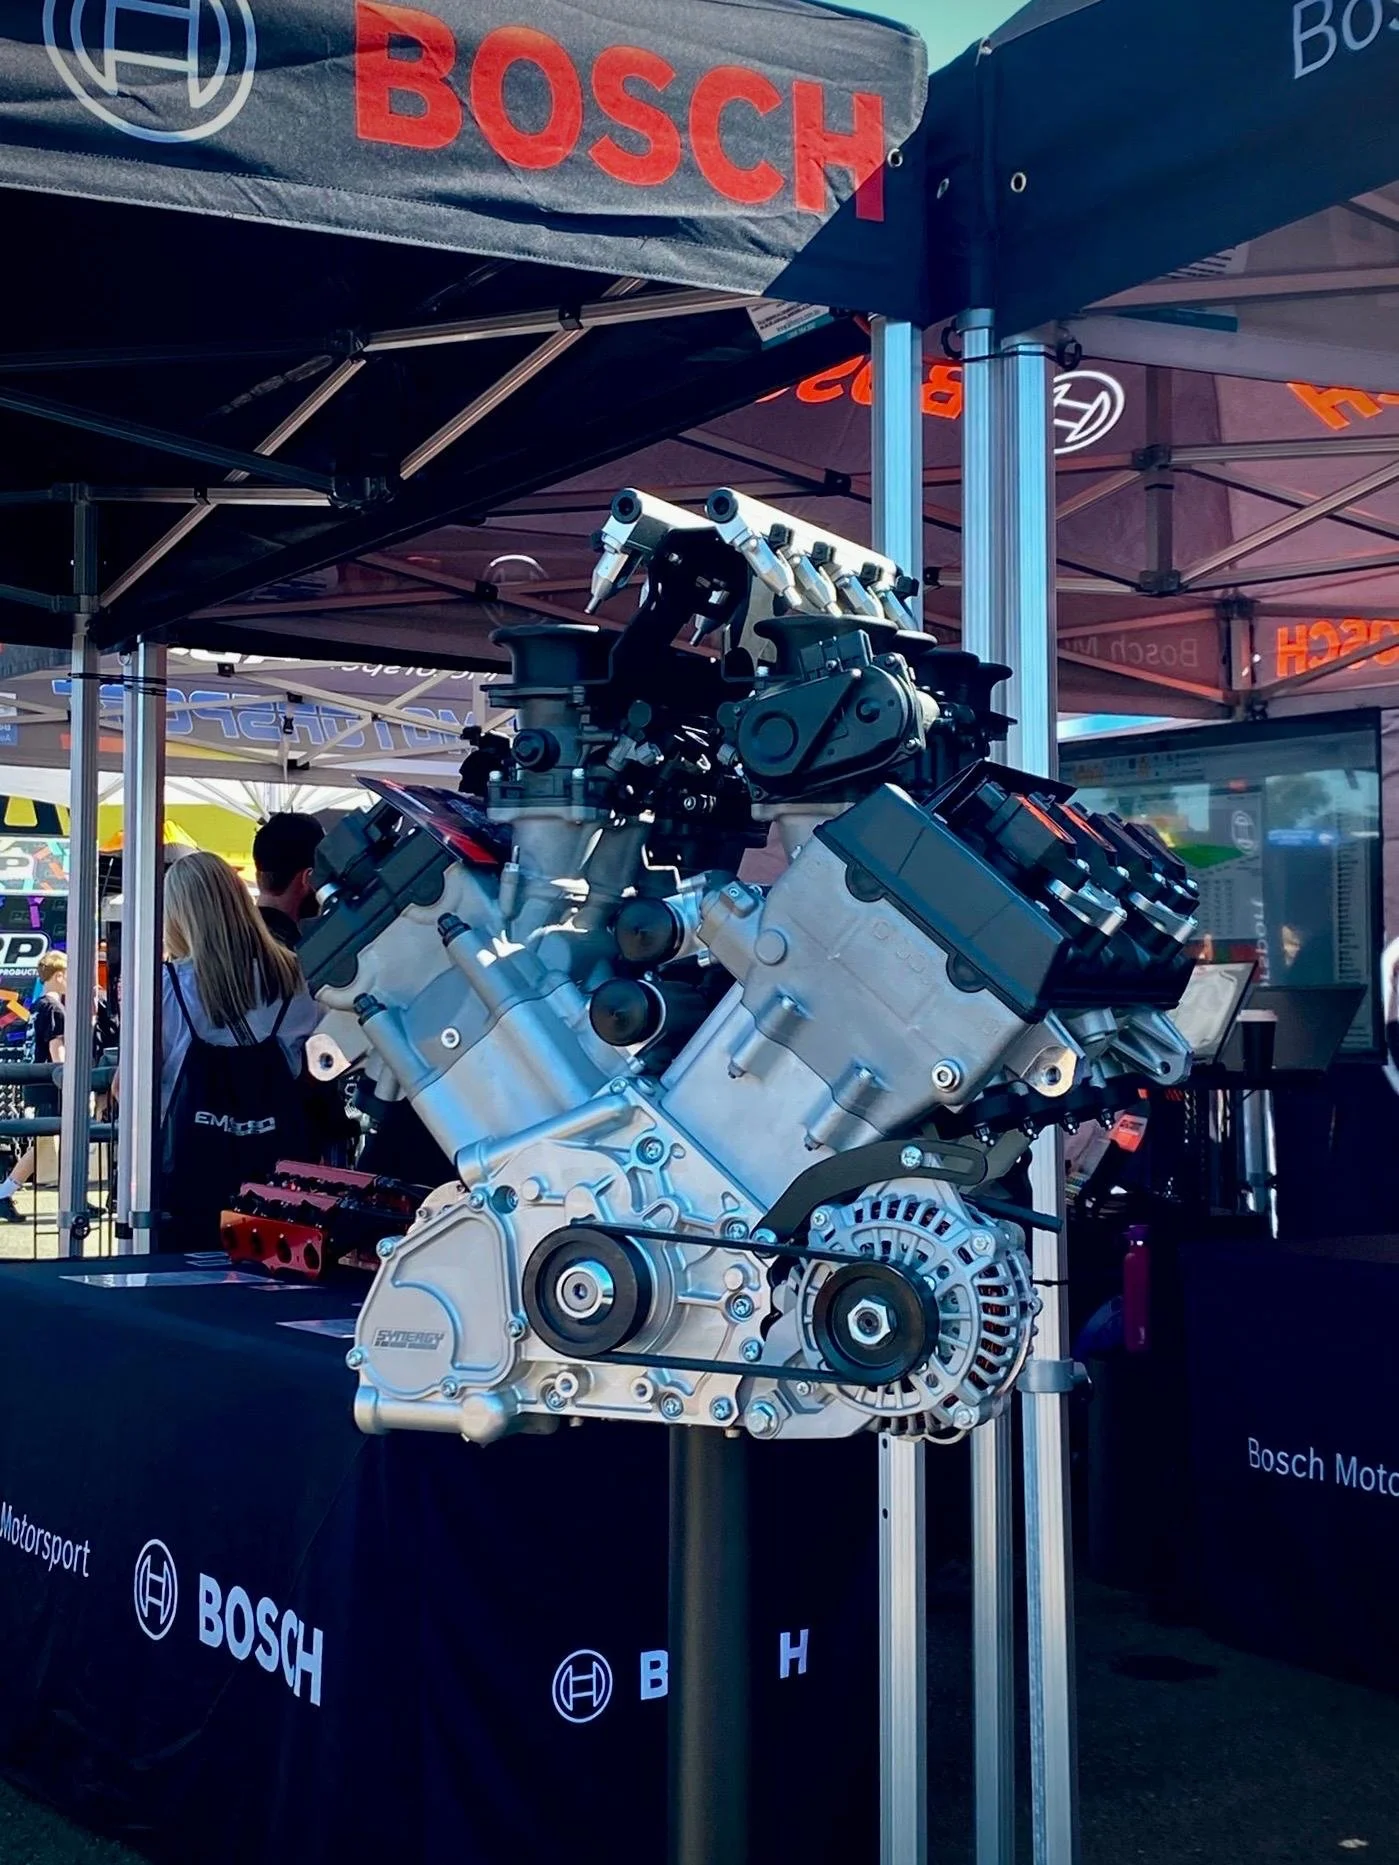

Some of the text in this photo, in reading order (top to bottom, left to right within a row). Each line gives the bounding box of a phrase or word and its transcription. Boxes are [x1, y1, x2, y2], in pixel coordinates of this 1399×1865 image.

[1293, 0, 1399, 79] Bo
[355, 0, 885, 222] BOSCH
[376, 1329, 444, 1346] SYNERGY
[1248, 1437, 1324, 1481] Bosch
[0, 1501, 91, 1578] Motorsport
[199, 1572, 323, 1707] BOSCH
